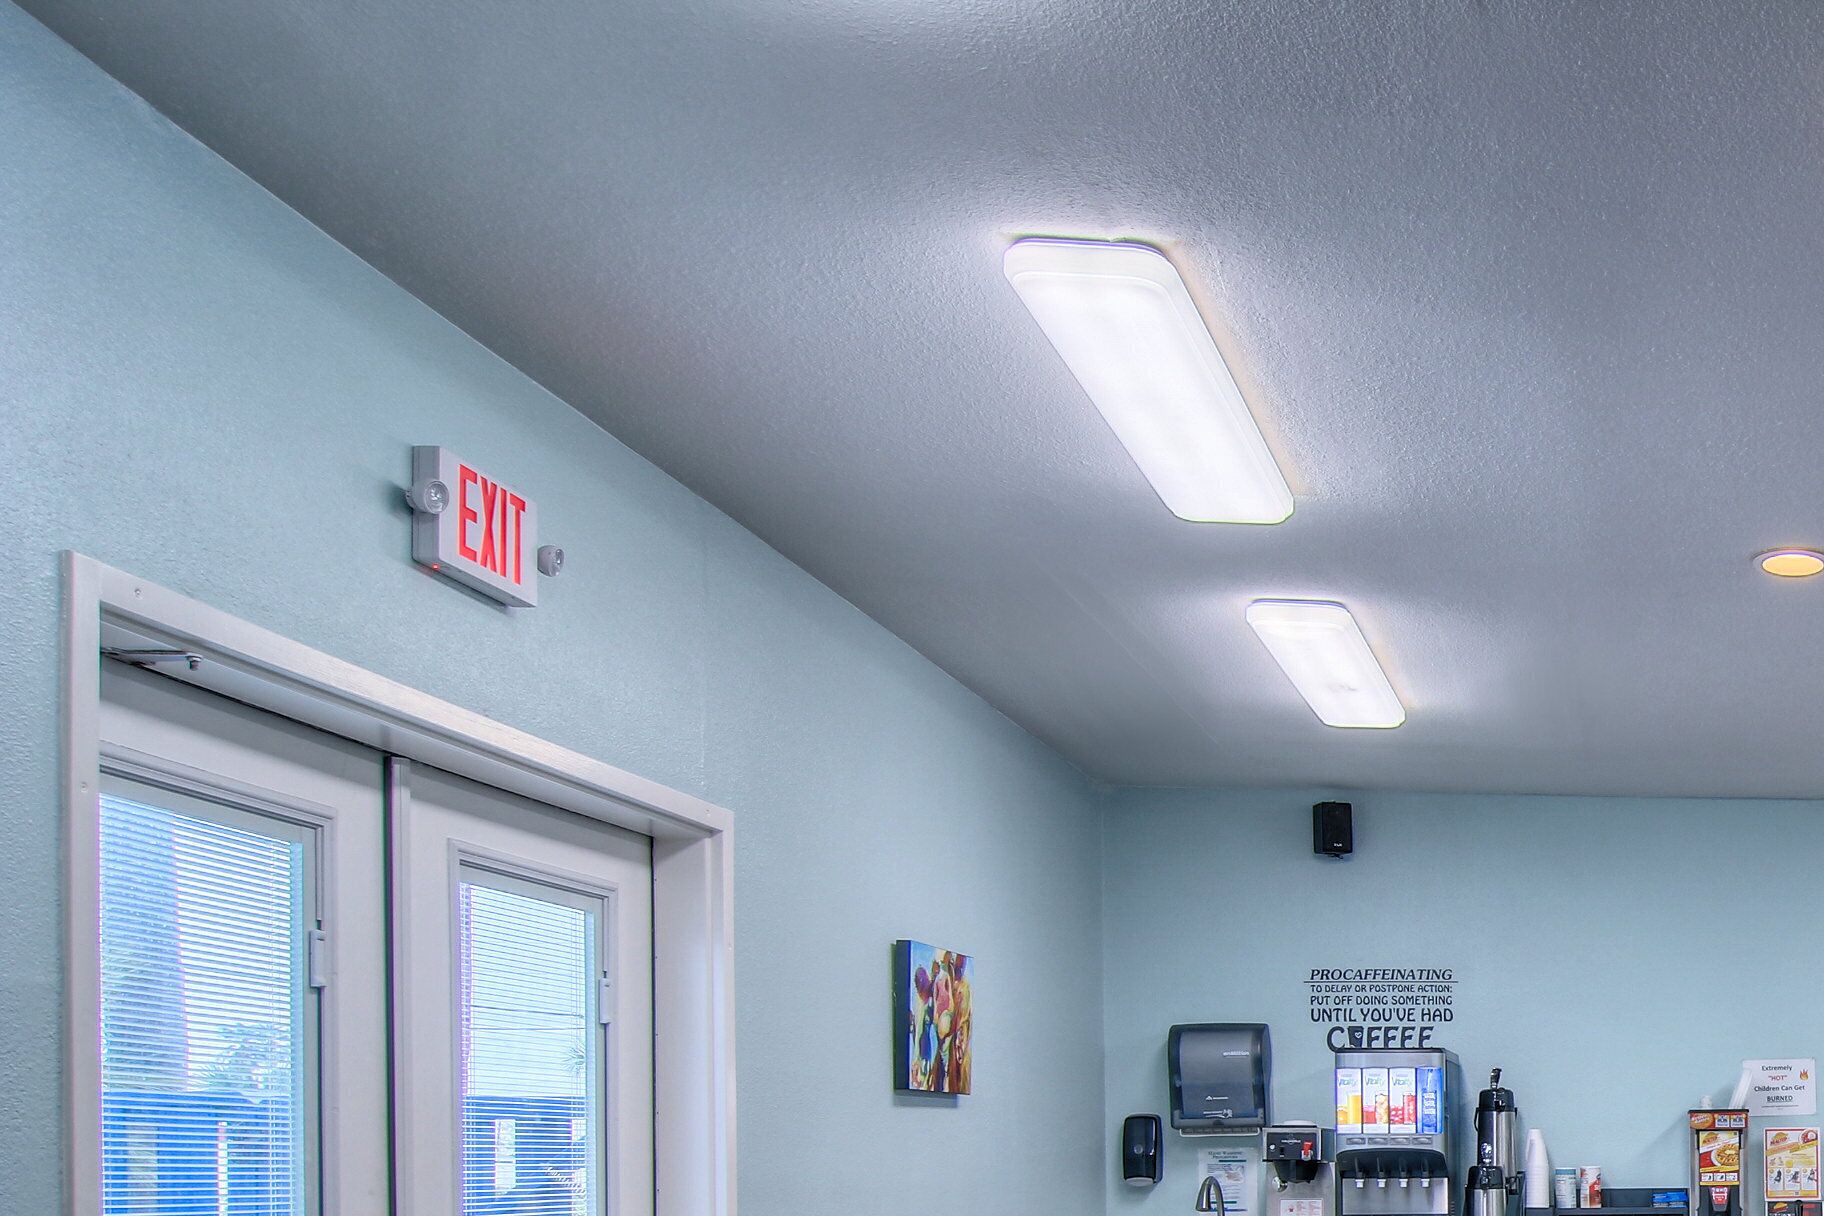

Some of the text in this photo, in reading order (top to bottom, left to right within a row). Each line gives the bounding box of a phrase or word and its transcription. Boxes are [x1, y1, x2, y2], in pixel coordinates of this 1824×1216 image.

[459, 464, 526, 586] EXIT
[1310, 969, 1453, 981] PROCAFFEINATING
[1310, 985, 1453, 993] TO DELAY OR POSTPONE ACTION:
[1310, 996, 1453, 1006] PUT OFF DOING SOMETHING
[1310, 1008, 1454, 1022] UNTIL YOU'VE HAD
